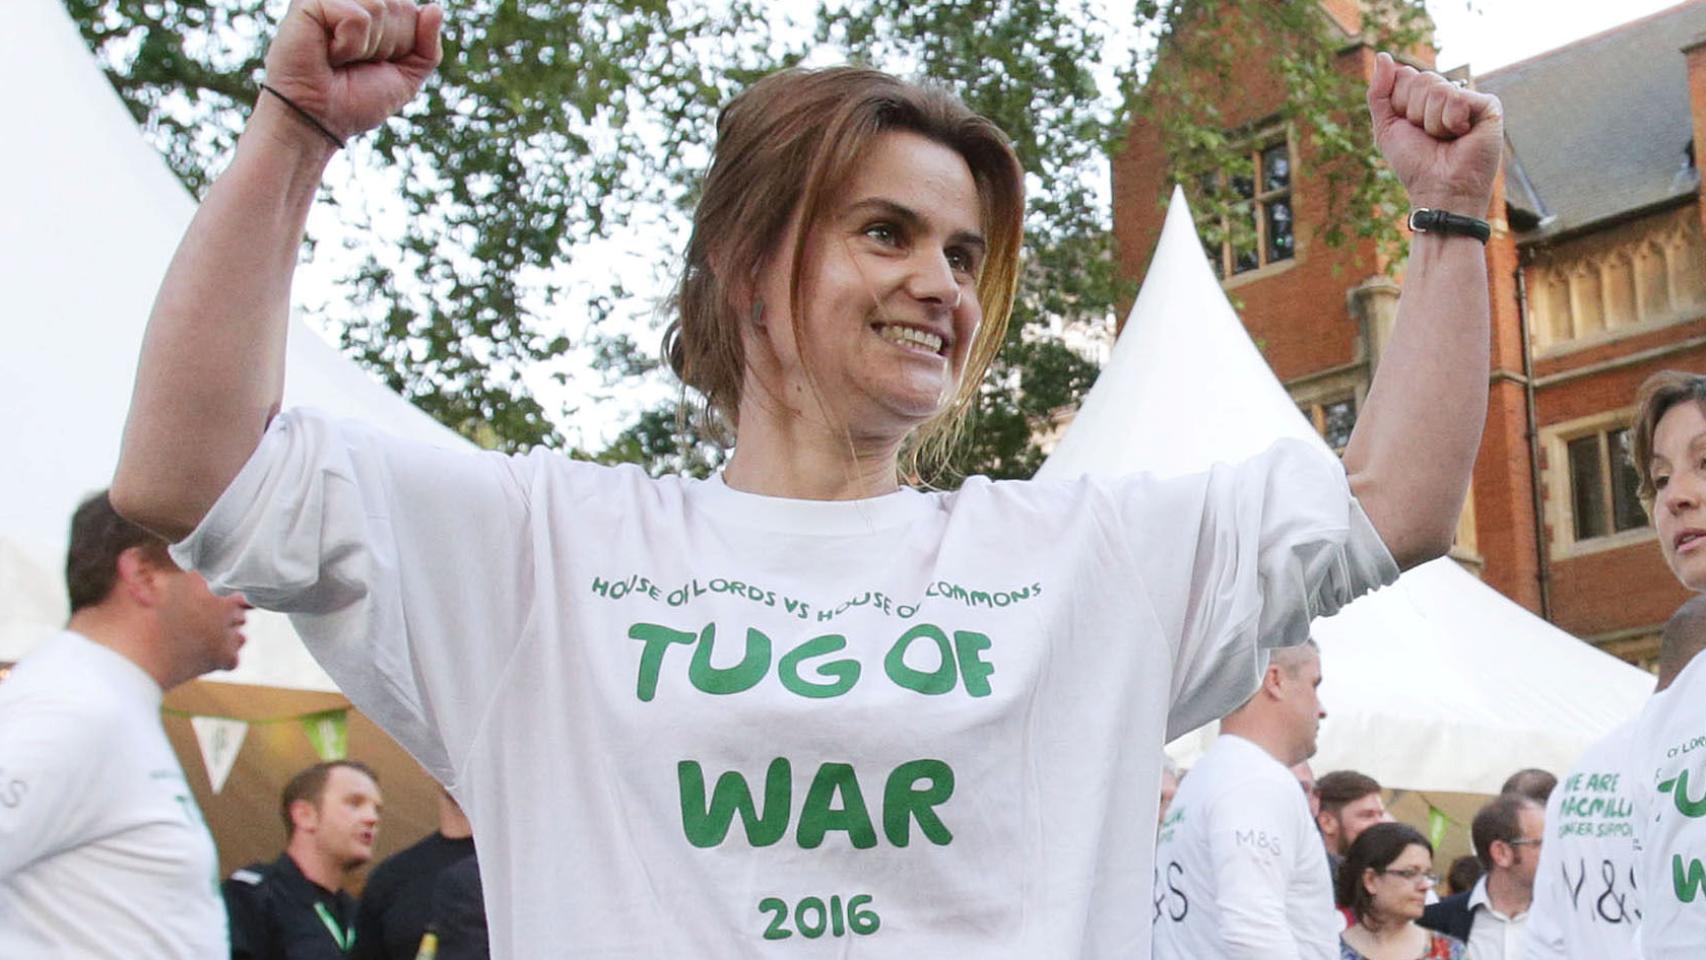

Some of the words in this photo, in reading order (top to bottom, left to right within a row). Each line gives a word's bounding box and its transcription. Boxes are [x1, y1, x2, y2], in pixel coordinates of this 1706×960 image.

[592, 574, 662, 601] HOUSE
[693, 578, 777, 607] LORDS
[784, 596, 810, 619] VS
[817, 591, 892, 622] HOUSE
[925, 581, 1042, 609] COMMONS
[628, 622, 862, 702] TUG
[884, 624, 995, 698] OF
[678, 757, 955, 849] WAR
[1586, 773, 1621, 793] ARE
[1235, 829, 1281, 857] M&S
[758, 894, 881, 940] 2016
